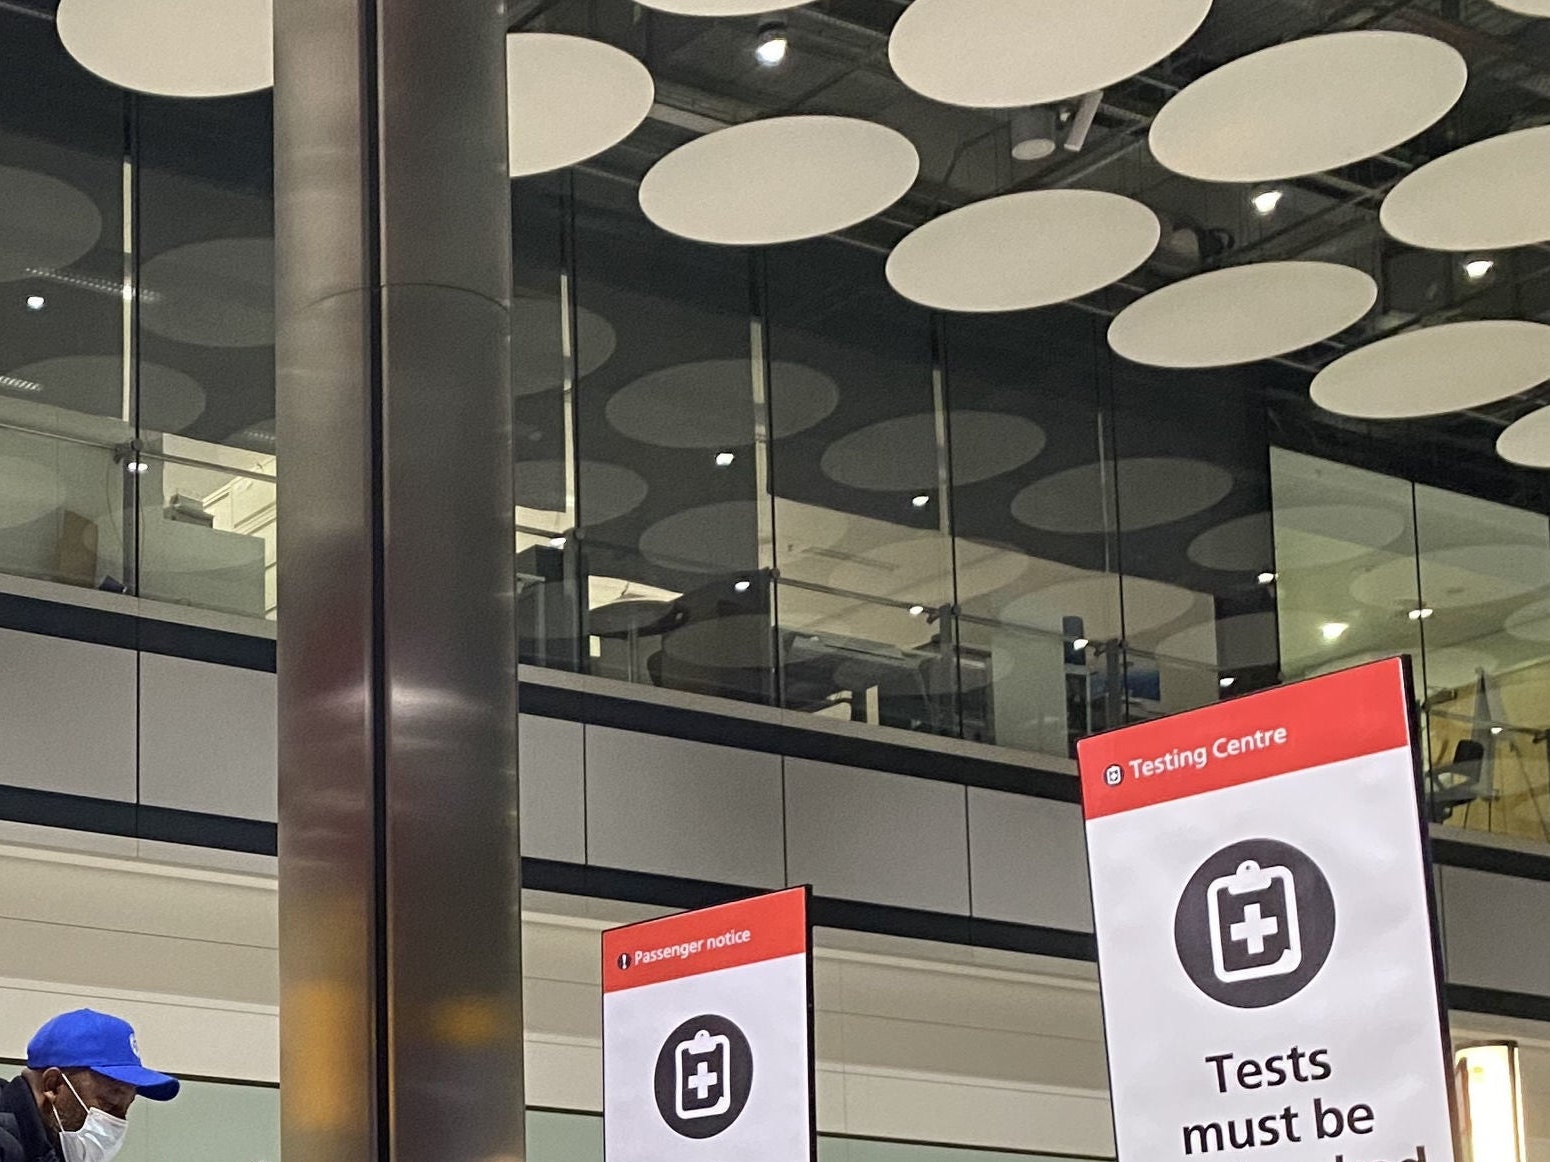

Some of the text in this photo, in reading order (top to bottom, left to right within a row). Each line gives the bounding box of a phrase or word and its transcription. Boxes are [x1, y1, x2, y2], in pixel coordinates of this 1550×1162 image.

[1129, 724, 1288, 781] Testing Centre
[634, 930, 752, 966] Passenger notice
[1205, 1045, 1332, 1094] Tests
[1182, 1098, 1375, 1154] must be
